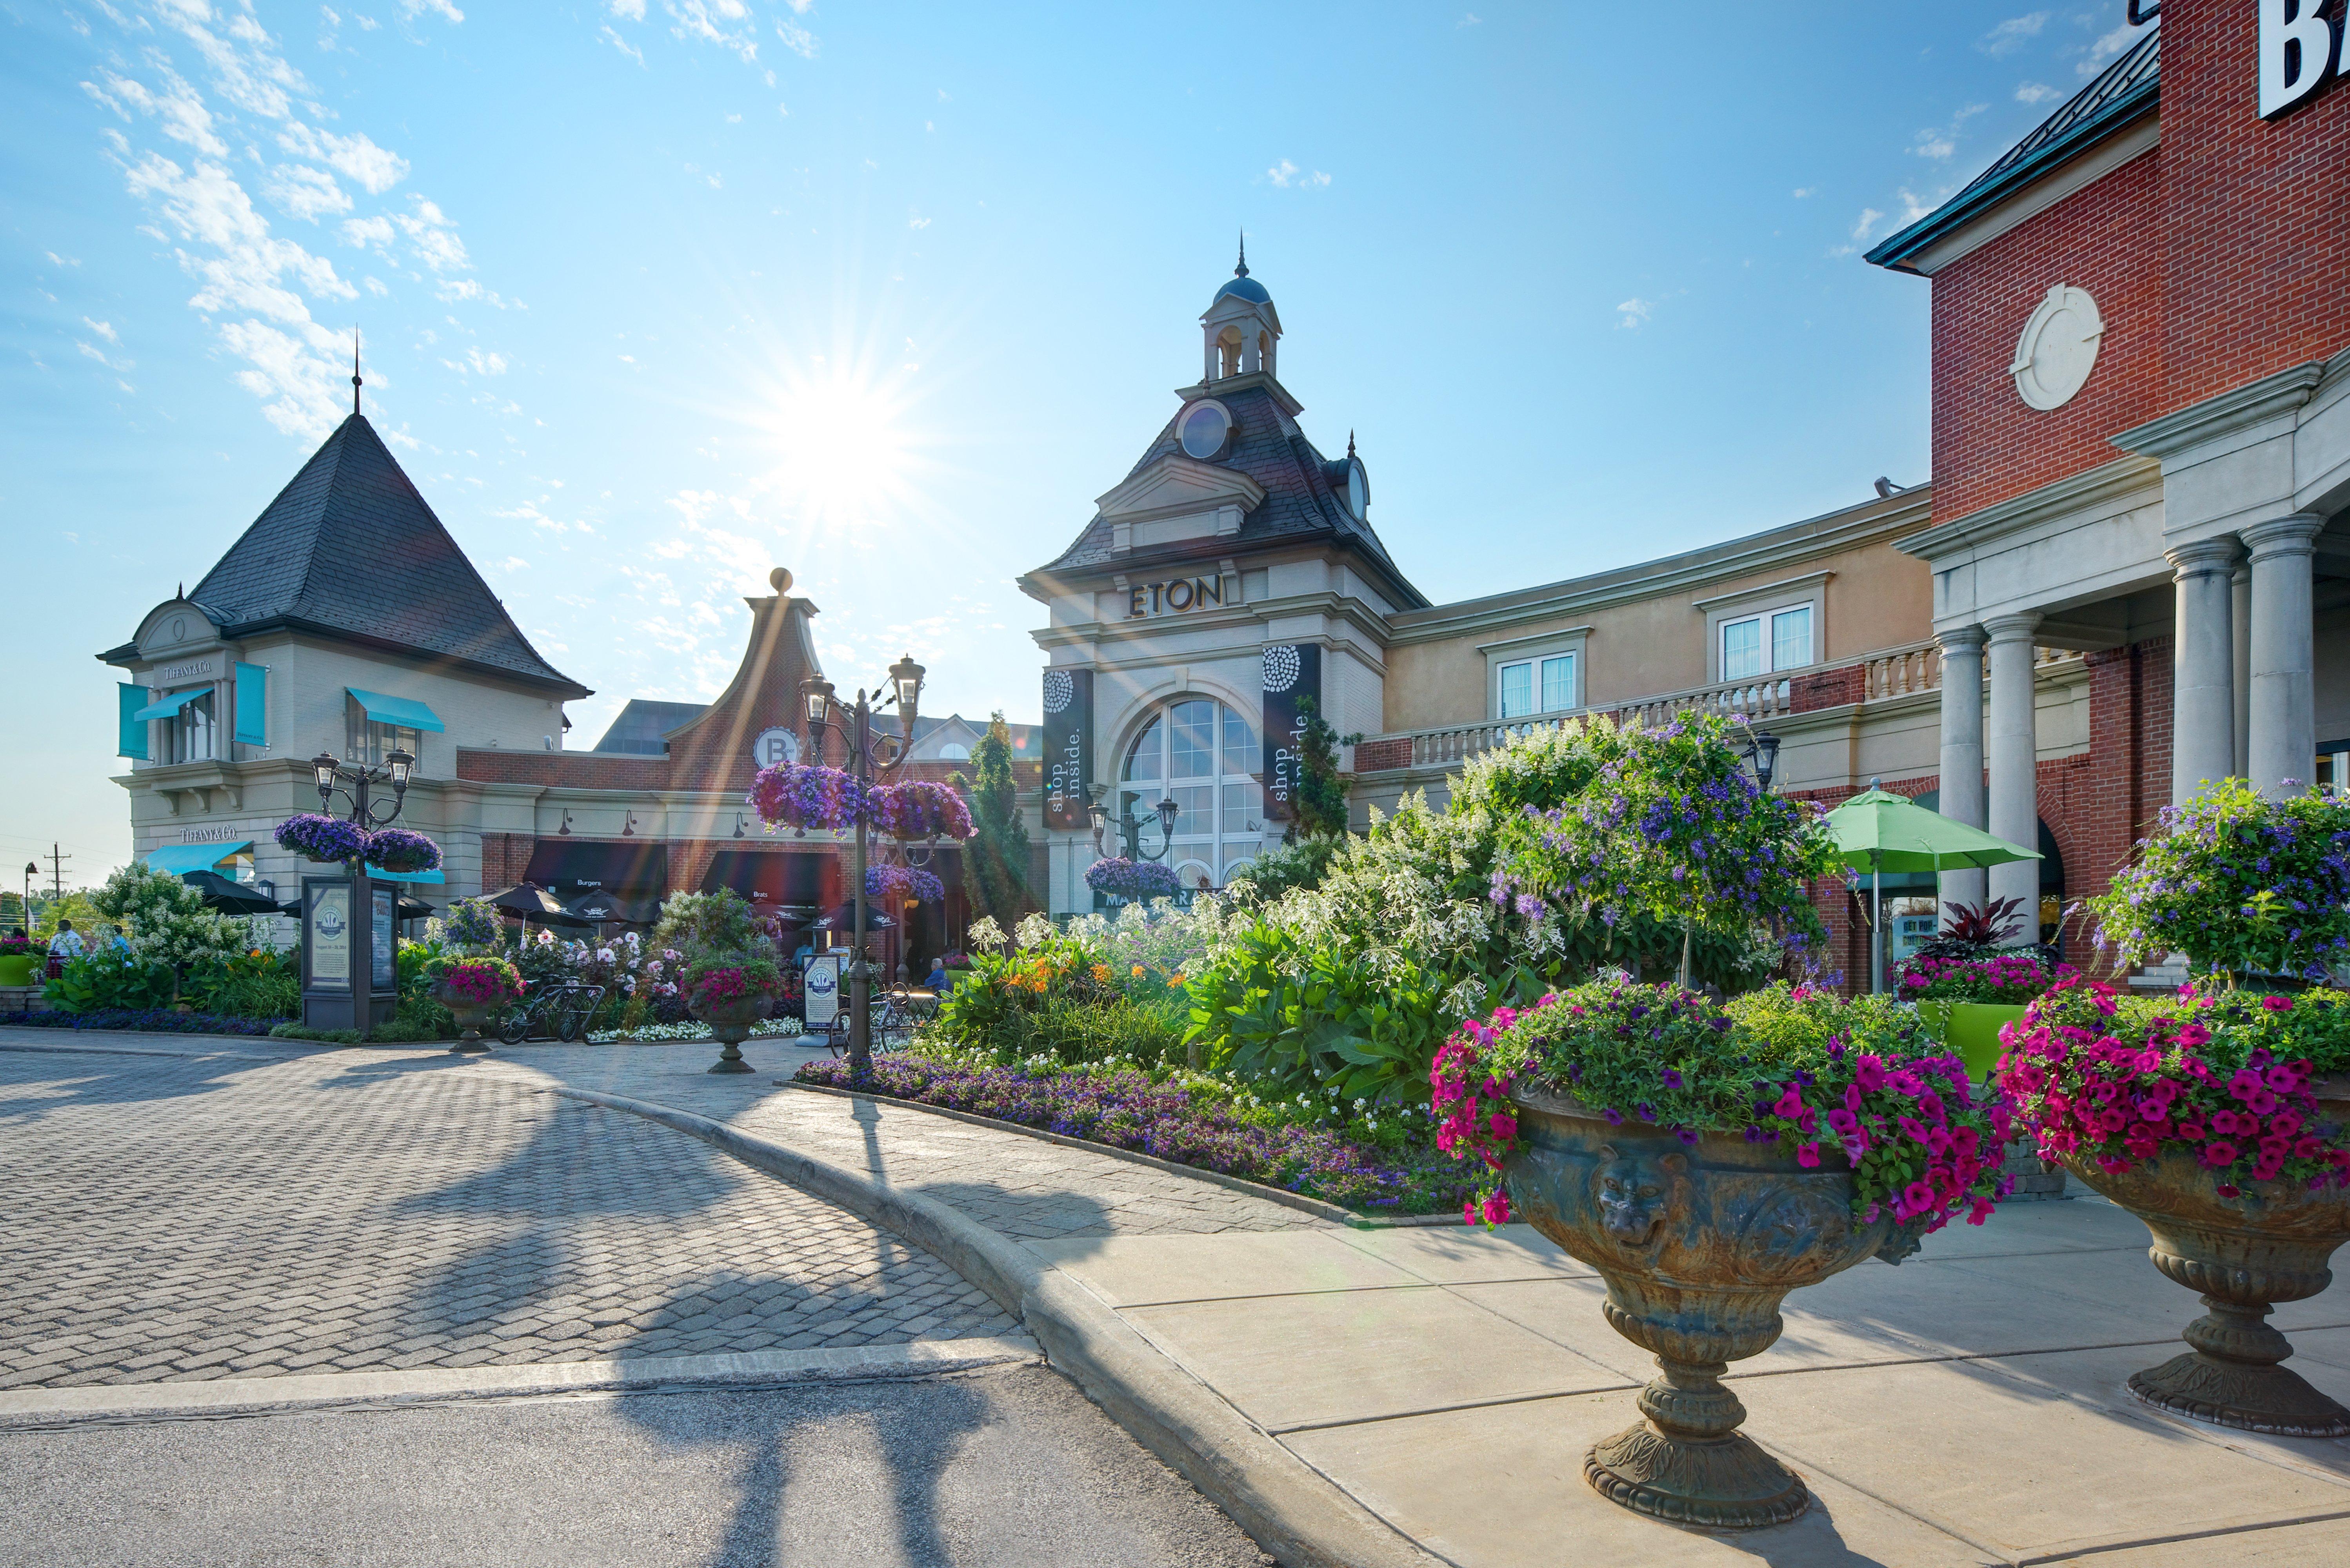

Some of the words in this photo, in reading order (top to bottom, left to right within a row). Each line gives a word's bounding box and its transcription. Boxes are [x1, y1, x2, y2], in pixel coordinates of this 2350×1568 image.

[1130, 574, 1222, 617] ETON
[767, 739, 787, 764] B
[1064, 728, 1080, 800] inside.
[1048, 764, 1068, 812] shop
[1270, 748, 1294, 801] shop
[1904, 921, 1916, 931] GET
[1919, 921, 1937, 931] POP-
